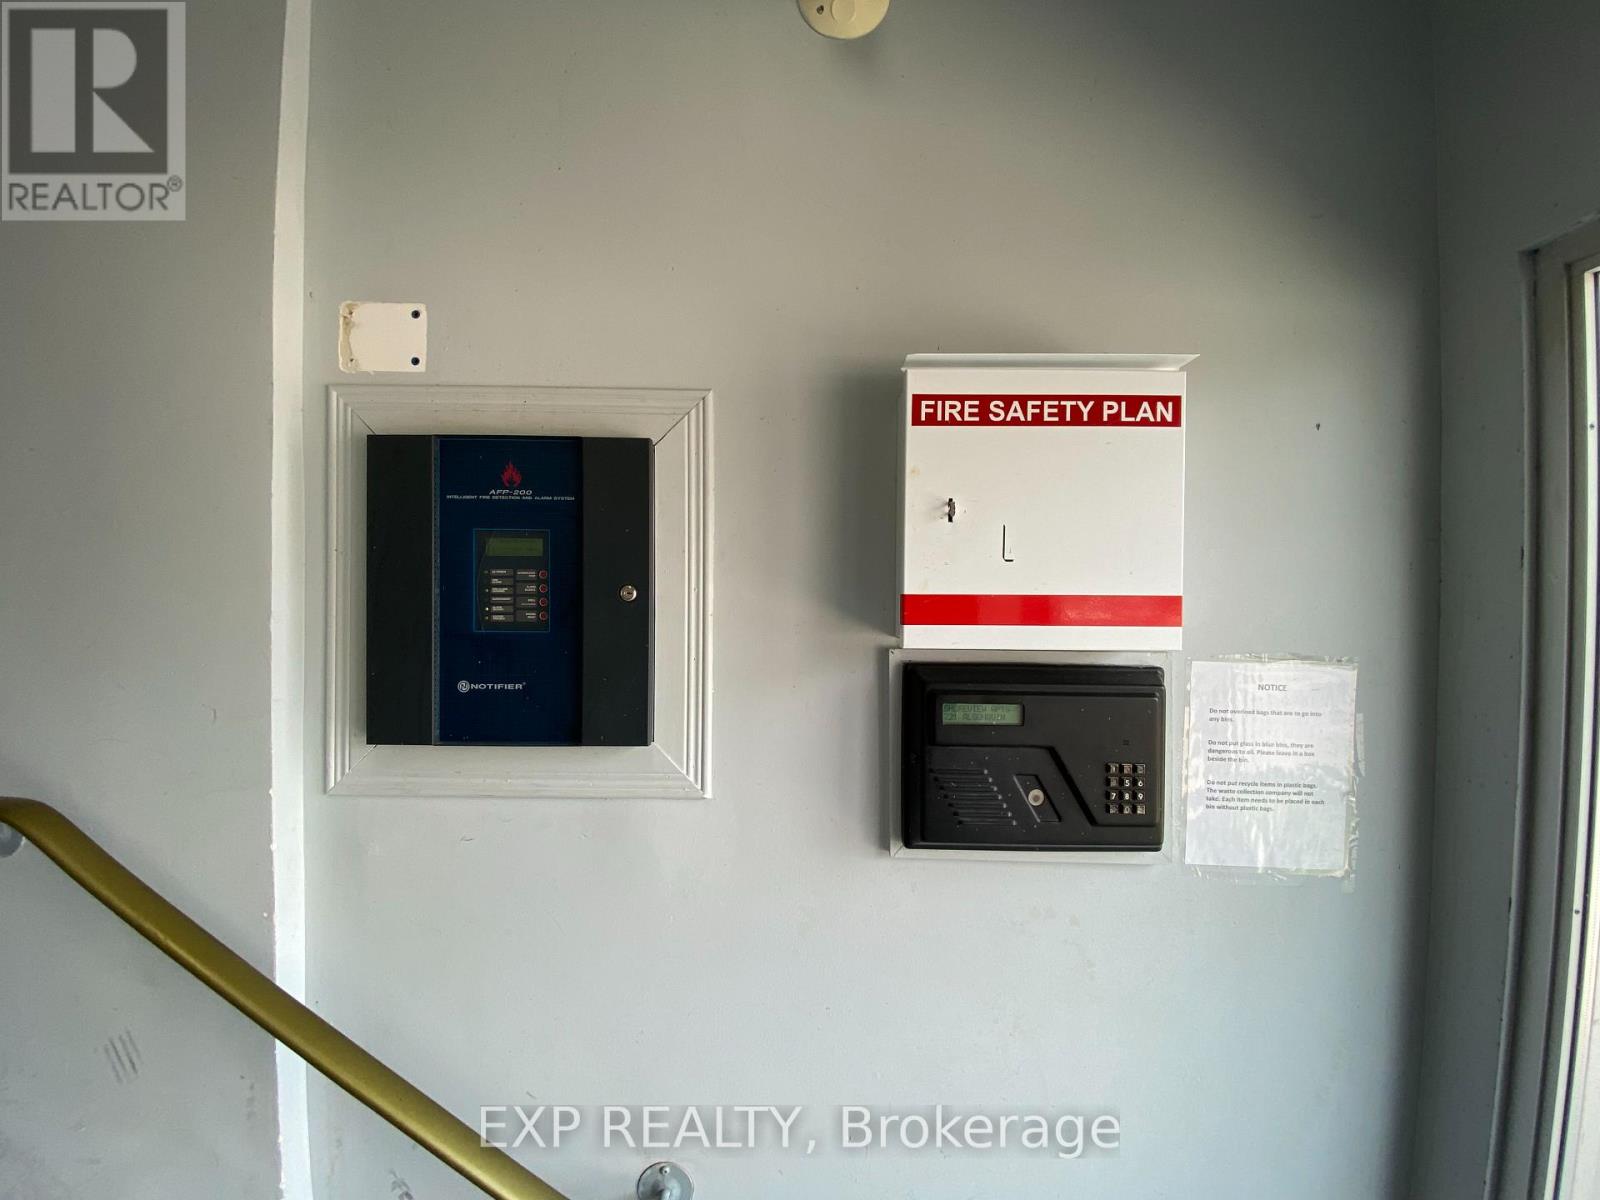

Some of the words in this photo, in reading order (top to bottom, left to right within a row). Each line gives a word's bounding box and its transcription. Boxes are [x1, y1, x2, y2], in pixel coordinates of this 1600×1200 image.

[920, 400, 980, 421] FIRE
[988, 400, 1094, 422] SAFETY
[1102, 401, 1173, 422] PLAN
[1258, 684, 1288, 692] NOTICE
